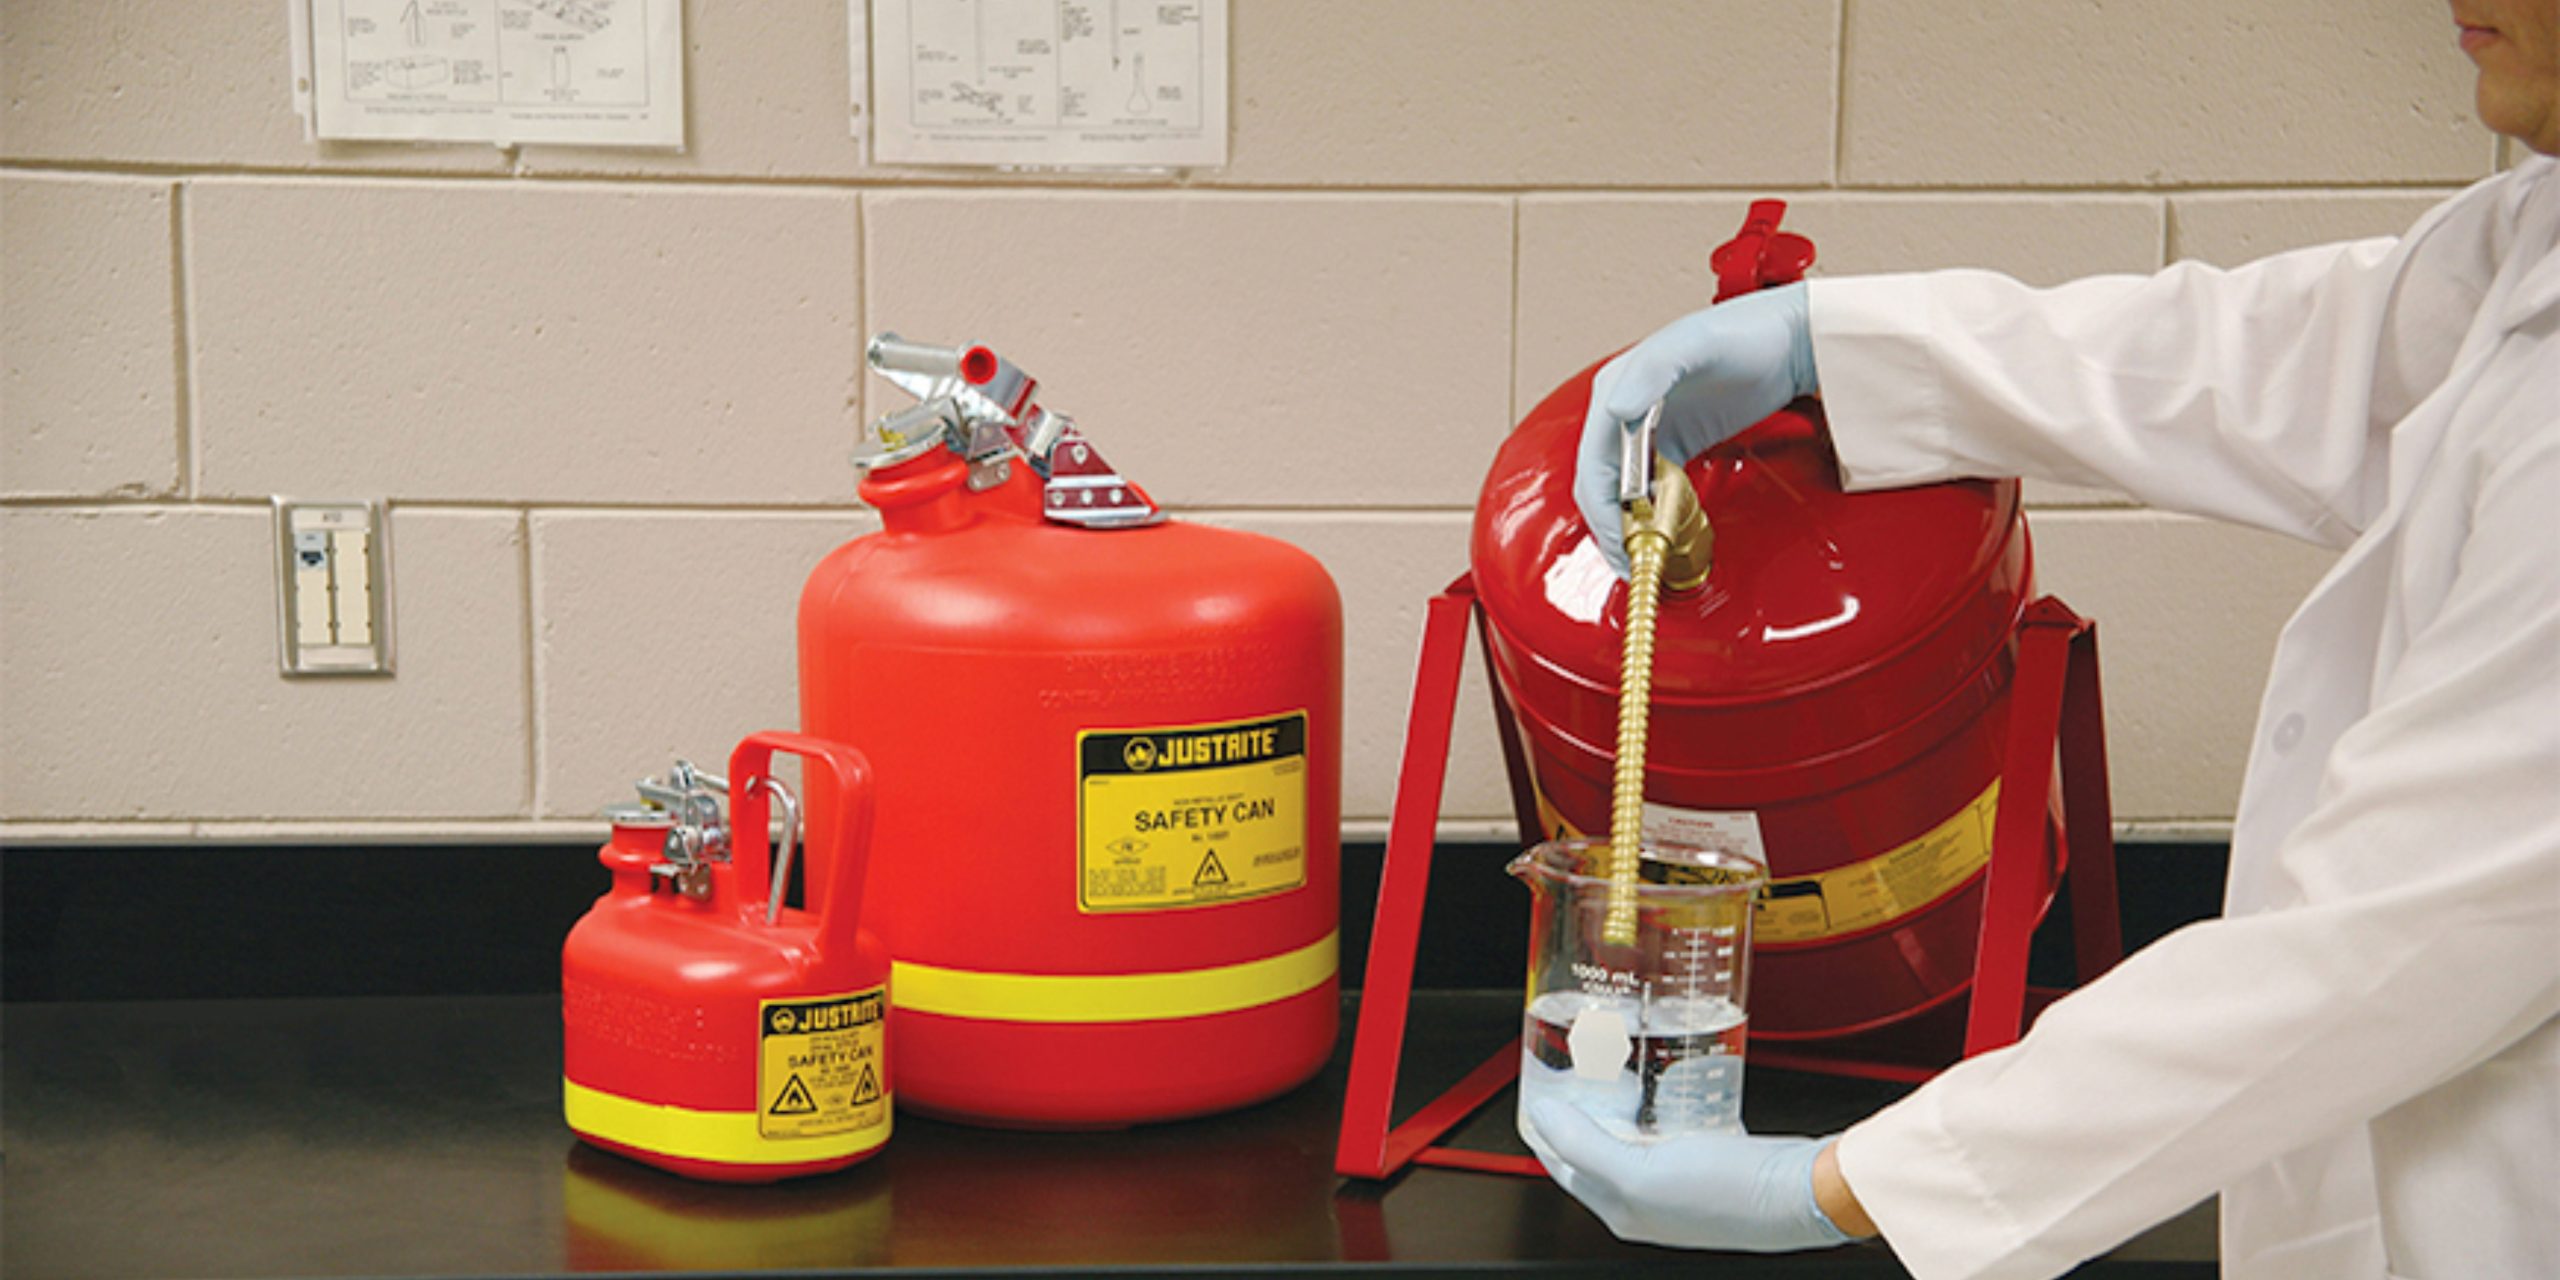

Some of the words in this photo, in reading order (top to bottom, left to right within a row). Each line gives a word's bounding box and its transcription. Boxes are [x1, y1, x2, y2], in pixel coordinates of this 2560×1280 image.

[1158, 728, 1276, 767] JUSTRITE
[1135, 806, 1228, 832] SAFETY
[1233, 798, 1275, 823] CAN
[1571, 963, 1607, 982] 1000
[788, 1052, 846, 1069] SAFETY
